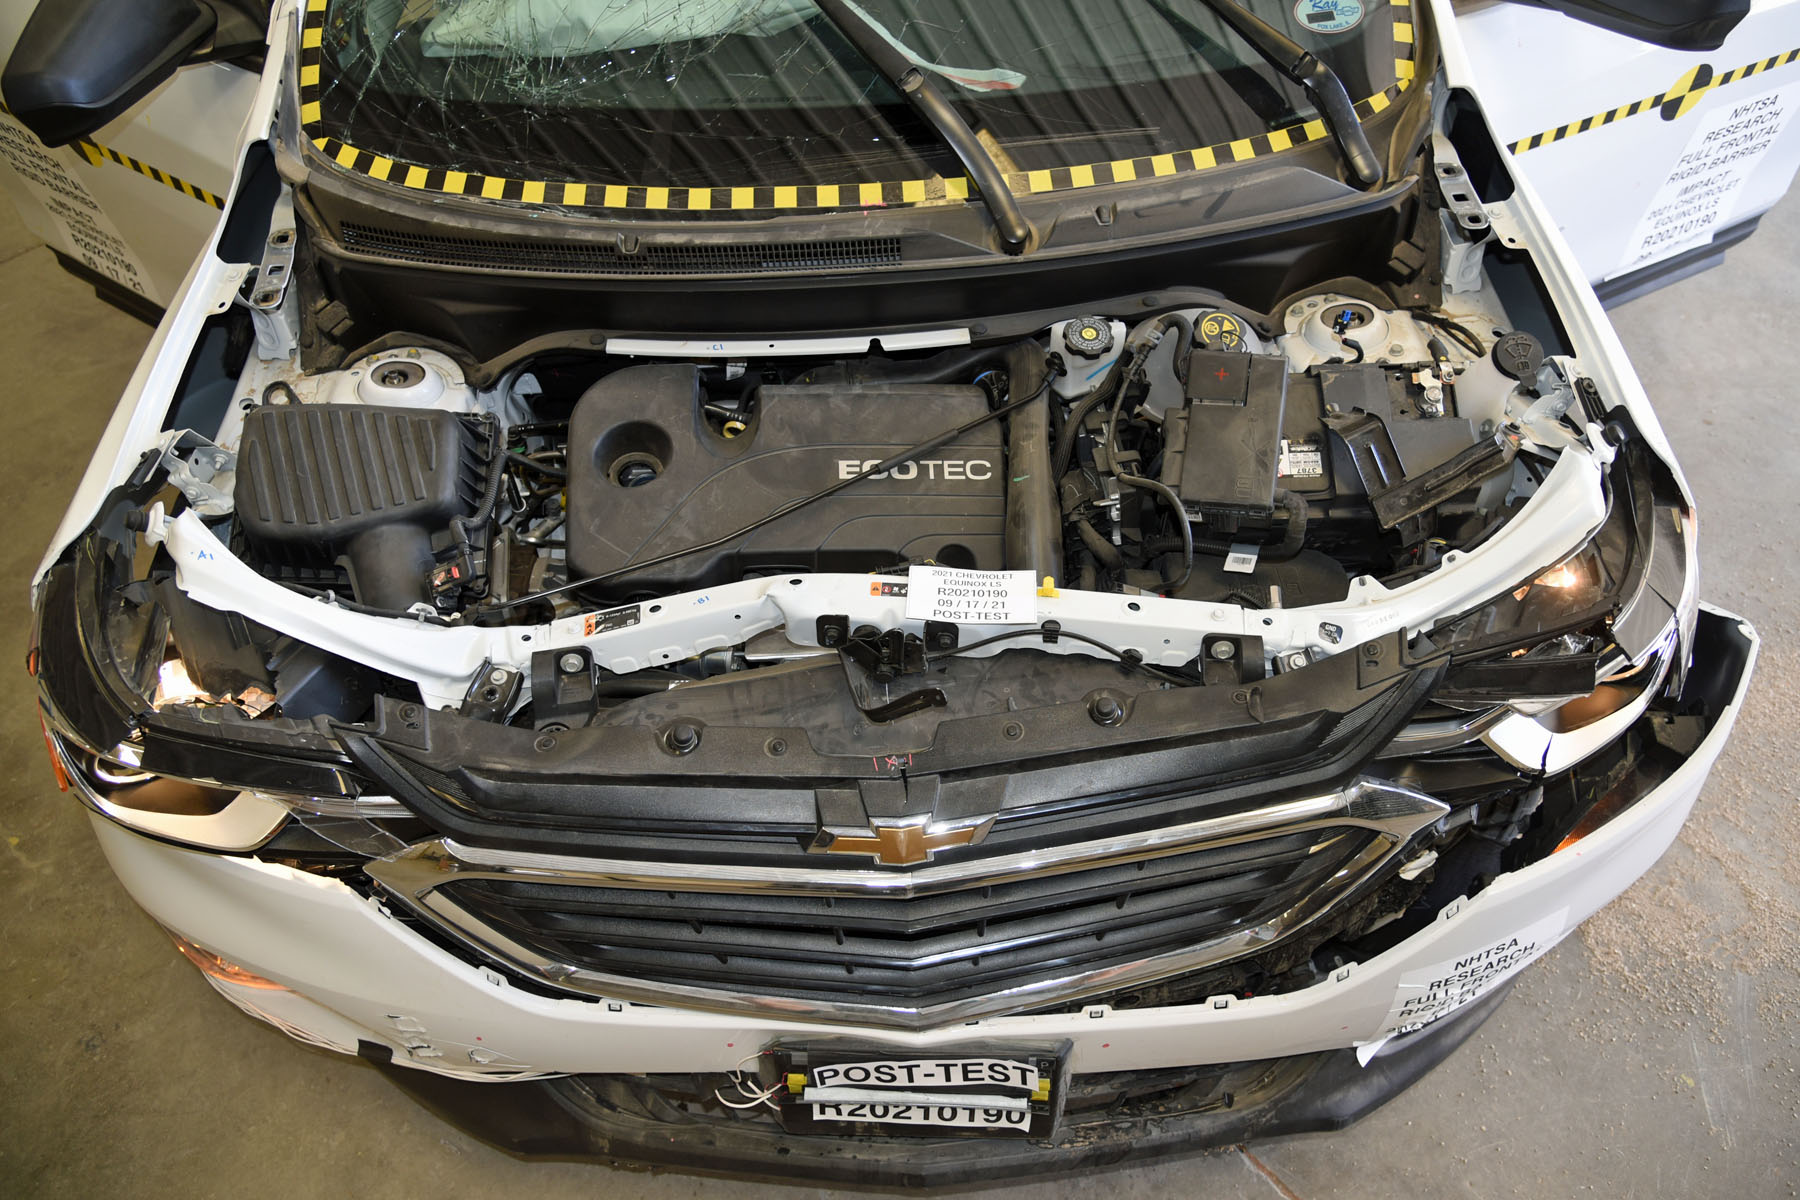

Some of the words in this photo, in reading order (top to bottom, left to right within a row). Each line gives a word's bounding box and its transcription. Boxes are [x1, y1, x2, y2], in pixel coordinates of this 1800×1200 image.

[1729, 94, 1779, 121] NHTSA
[1703, 108, 1783, 144] RESEARCH
[1677, 147, 1712, 168] FULL
[1716, 123, 1780, 154] FRONTAL
[1666, 162, 1706, 184] RIGID
[1708, 139, 1771, 169] BARRIER
[28, 159, 90, 197] FRONTAL
[1676, 169, 1732, 198] IMPACT
[1641, 210, 1717, 249] R20210190
[838, 459, 992, 481] ECOTEC
[197, 549, 214, 561] A1
[931, 569, 953, 578] 2021
[955, 571, 1014, 580] CHEVROLET
[943, 578, 988, 588] EQUINOX
[937, 587, 1008, 599] R20210190
[937, 598, 952, 609] 09
[966, 600, 980, 610] 17
[991, 601, 1006, 610] 21
[933, 609, 1010, 620] POST-TEST
[1429, 942, 1536, 991] RESEARCH
[1454, 937, 1519, 971] NHTSA
[816, 1061, 1035, 1087] POST-TEST
[819, 1103, 1026, 1125] R20210190
